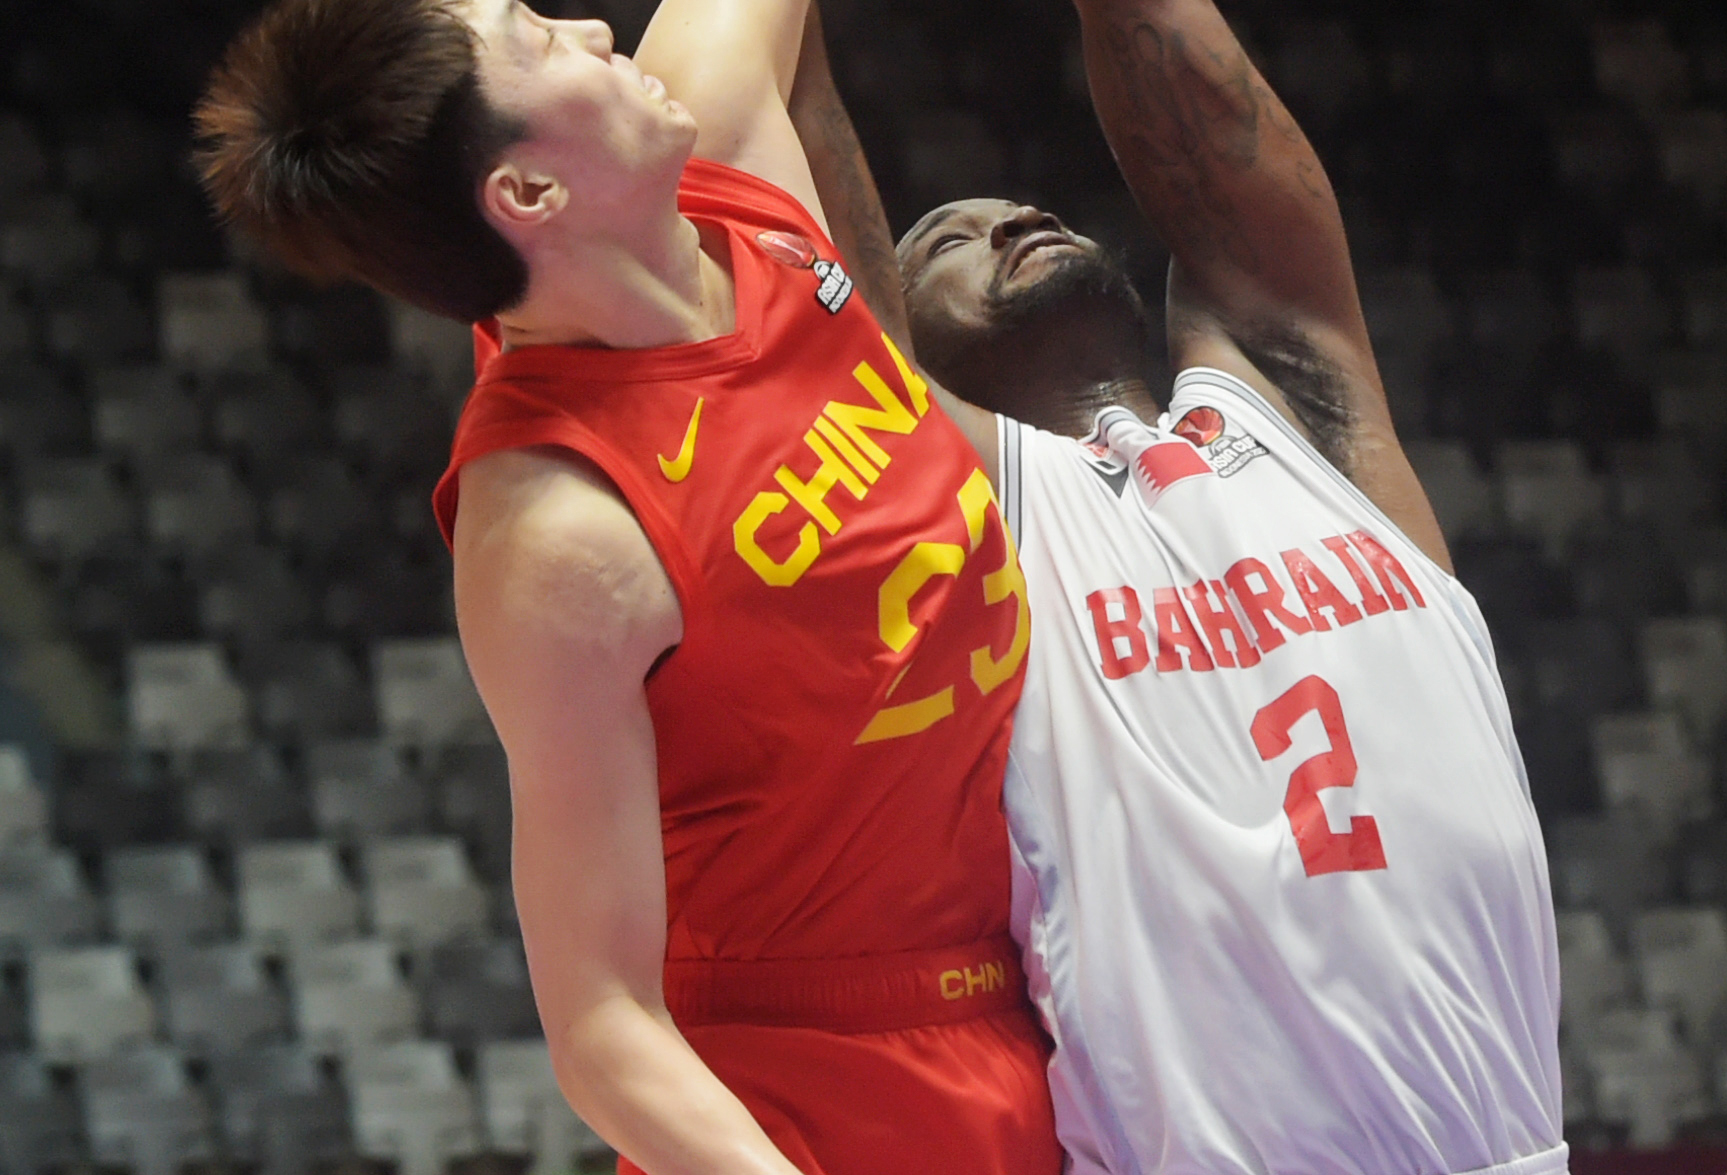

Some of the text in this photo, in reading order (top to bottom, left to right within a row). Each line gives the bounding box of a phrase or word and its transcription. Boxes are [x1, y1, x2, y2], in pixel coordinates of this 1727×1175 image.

[733, 331, 930, 587] CHINA
[854, 467, 1031, 745] 23
[1085, 529, 1427, 681] BAHRAIN
[1249, 673, 1388, 878] 2
[939, 960, 1005, 1000] CHN
